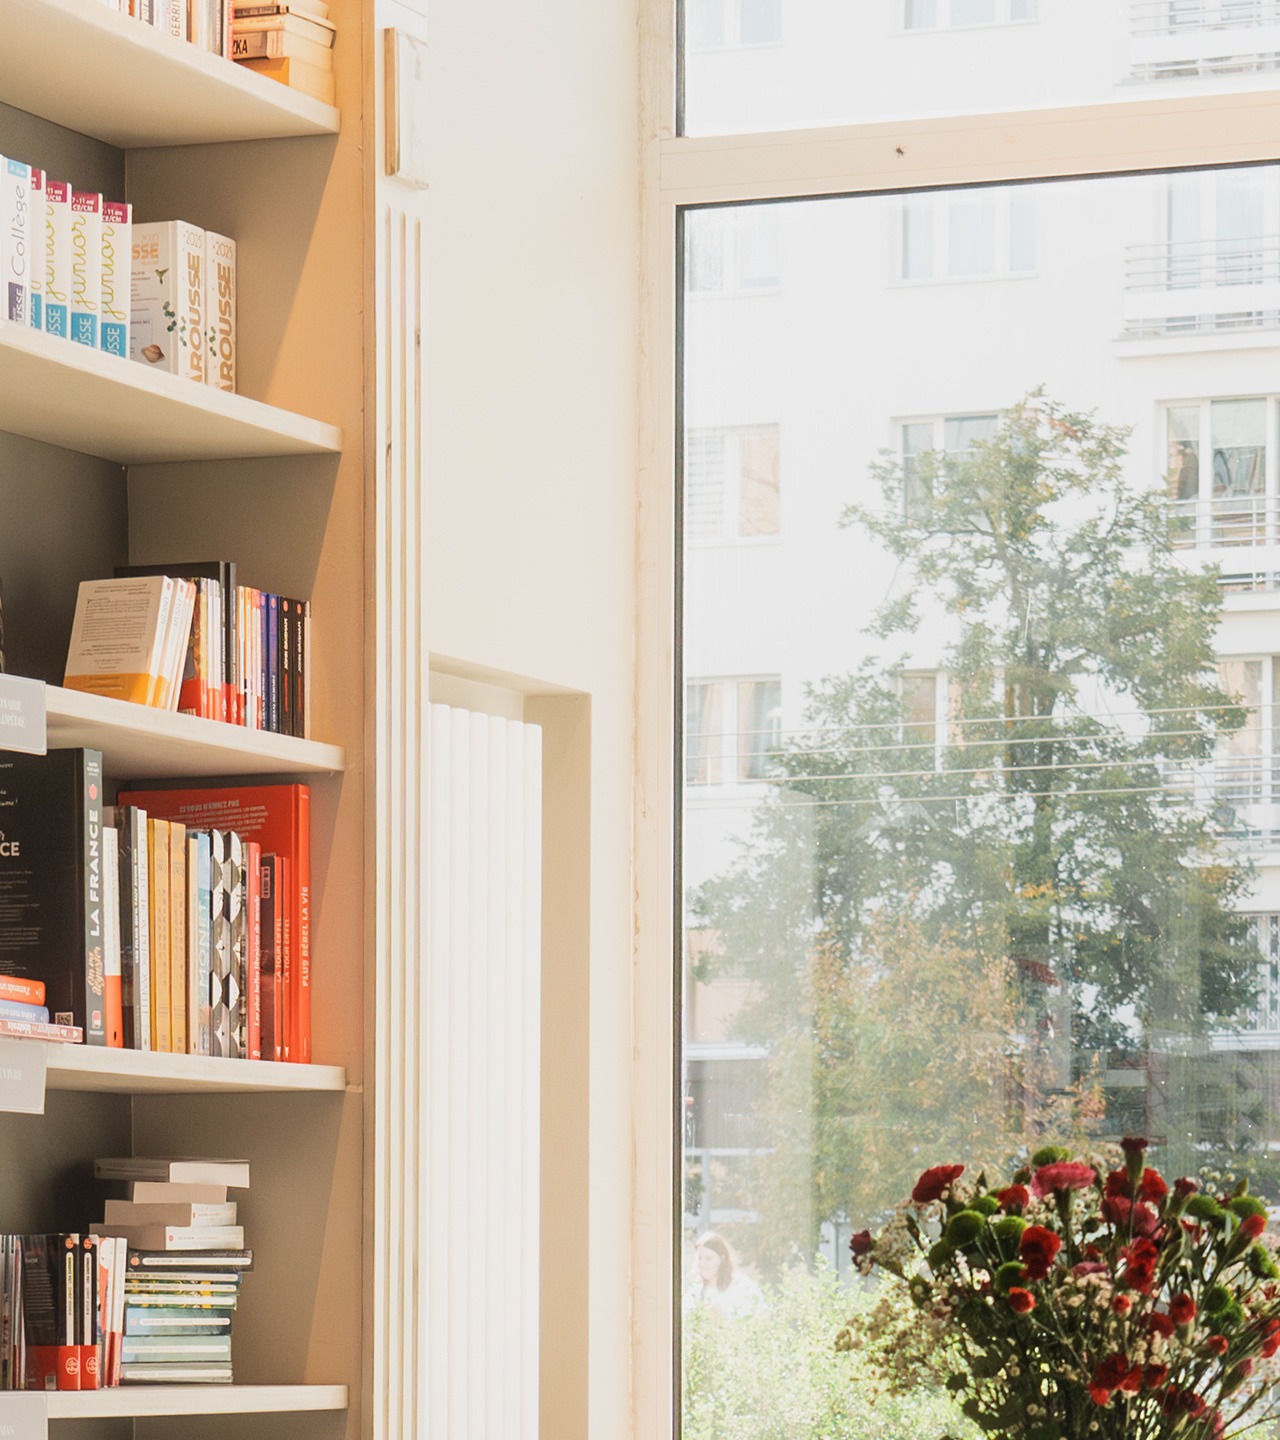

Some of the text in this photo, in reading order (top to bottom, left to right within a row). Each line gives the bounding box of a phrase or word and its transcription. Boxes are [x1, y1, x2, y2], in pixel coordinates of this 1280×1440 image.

[11, 185, 27, 277] Collège
[72, 204, 94, 212] CE/CM
[71, 214, 98, 311] junior
[132, 242, 160, 260] SSE
[185, 230, 202, 249] 2025
[215, 241, 233, 260] 2025
[101, 225, 127, 321] junior
[89, 809, 99, 937] LA FRANCE
[199, 904, 209, 989] MONET
[1, 1067, 22, 1080] VIVRE
